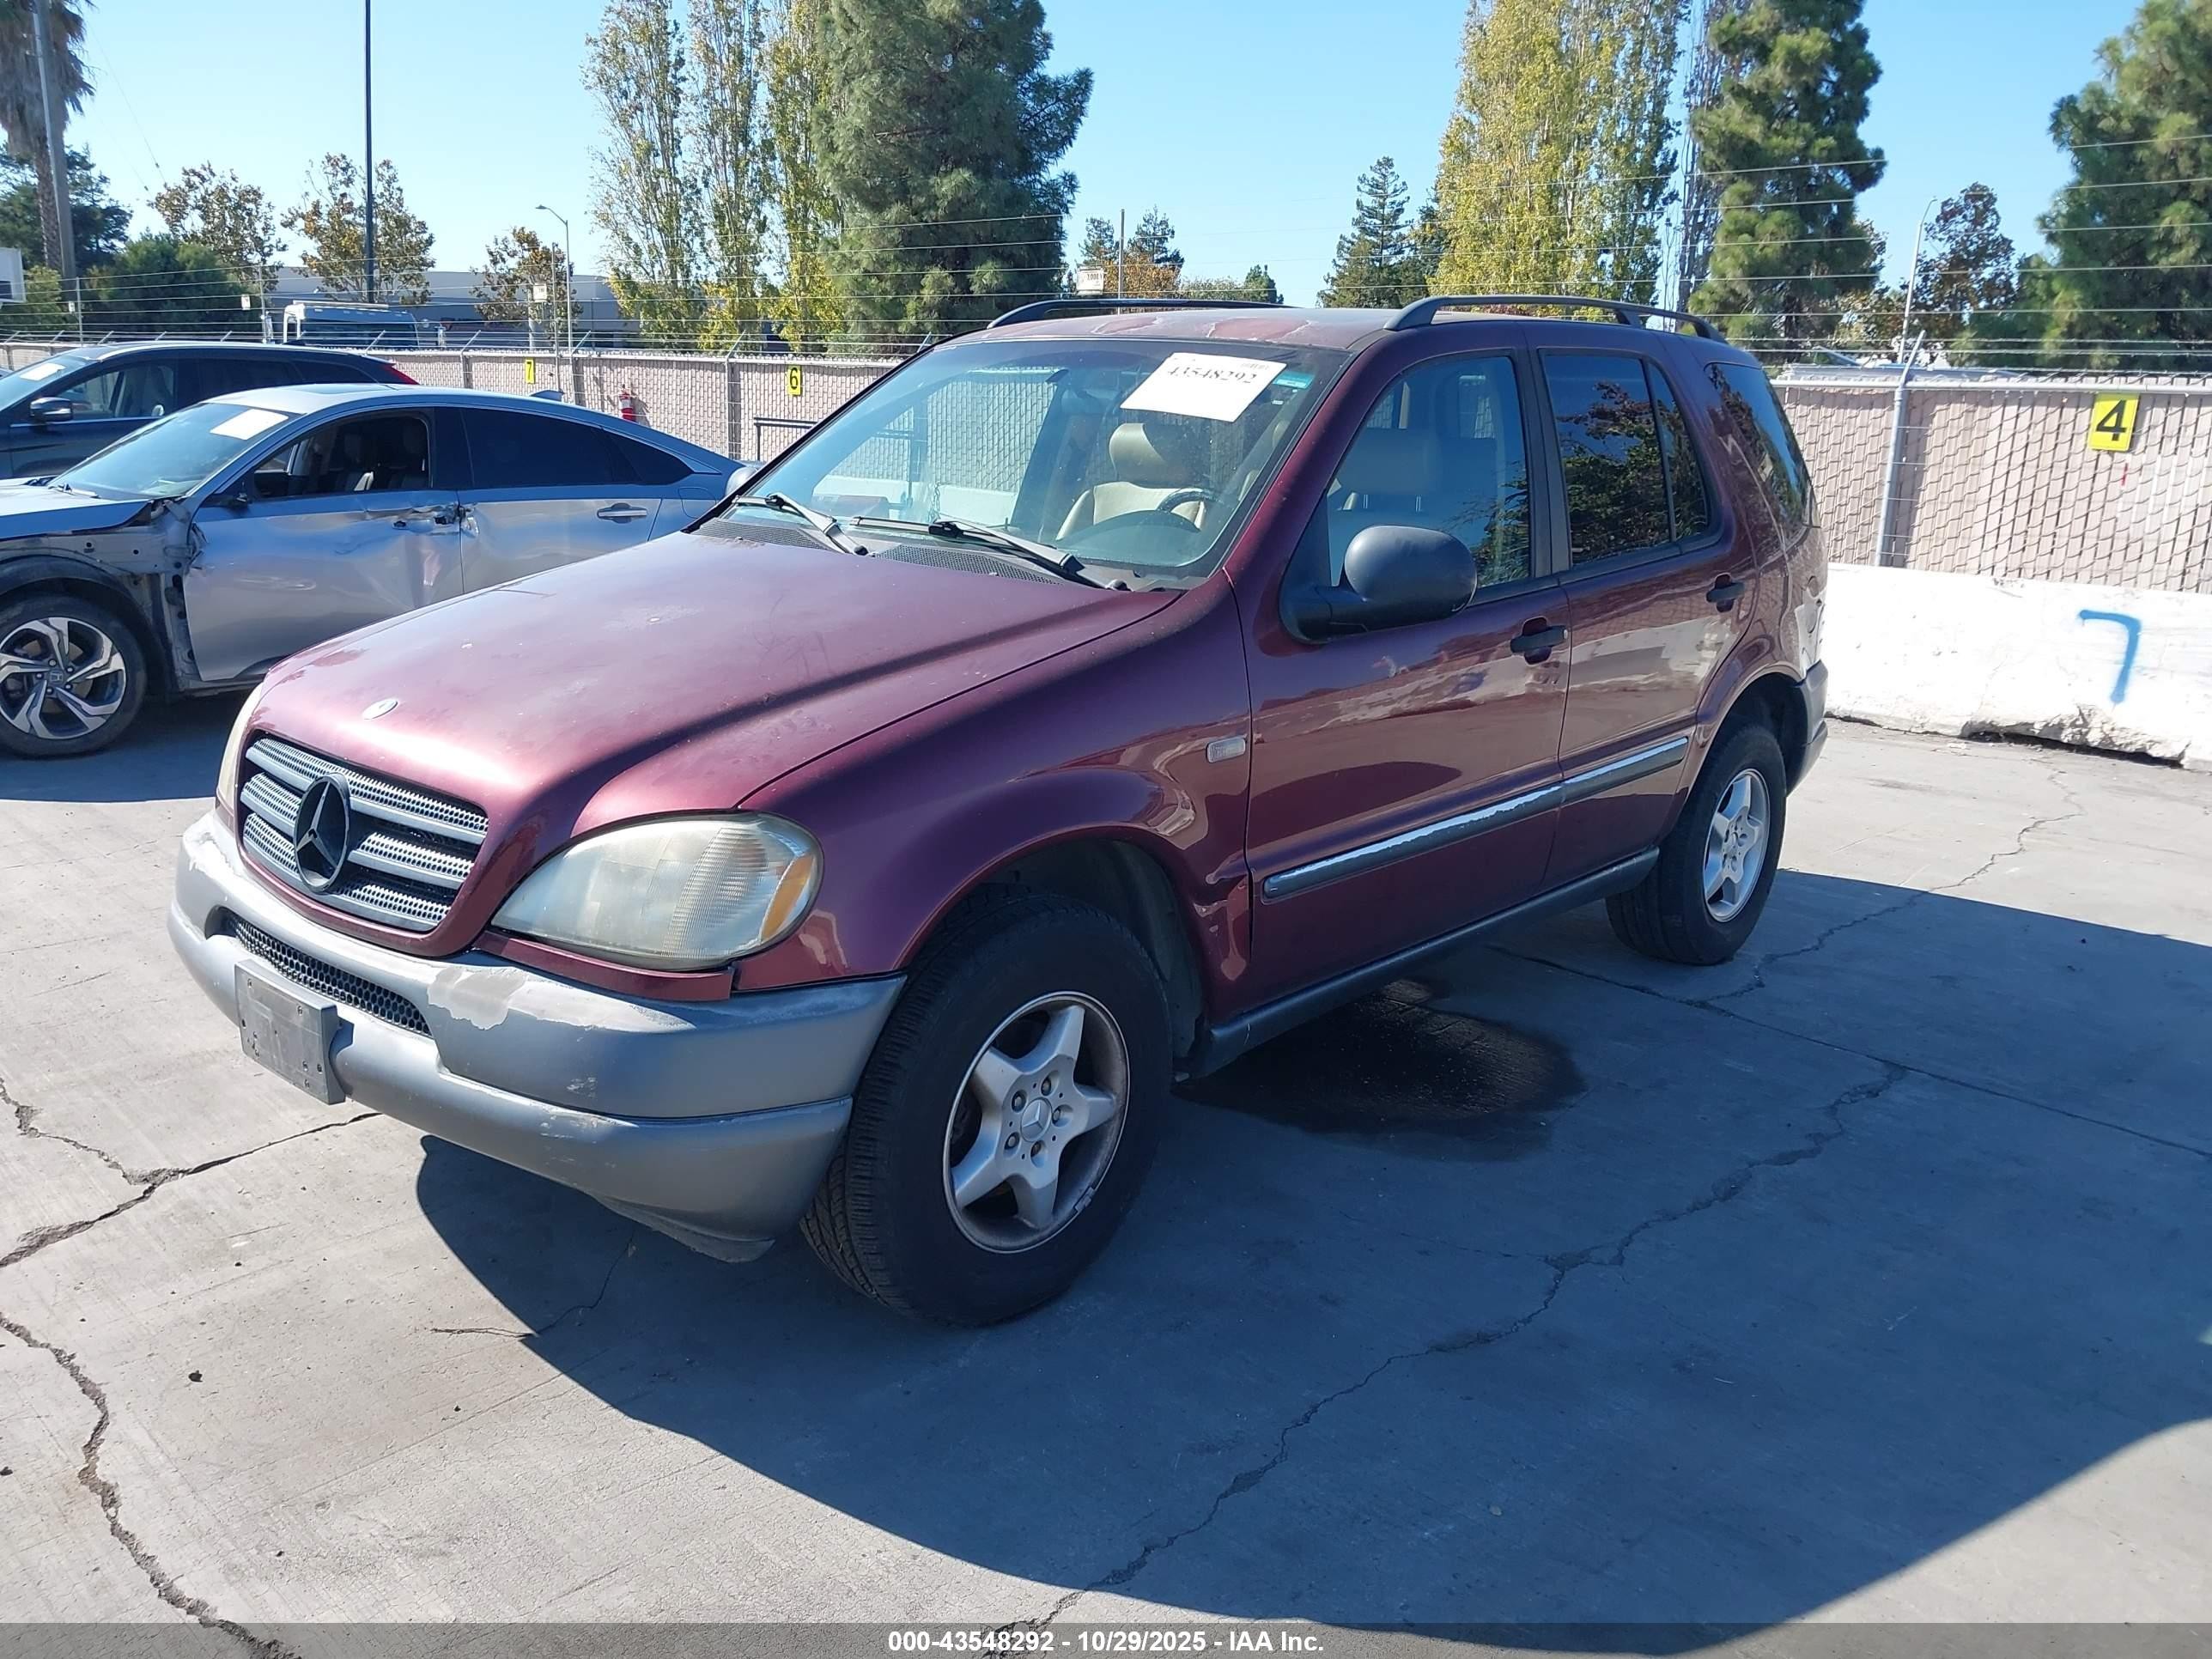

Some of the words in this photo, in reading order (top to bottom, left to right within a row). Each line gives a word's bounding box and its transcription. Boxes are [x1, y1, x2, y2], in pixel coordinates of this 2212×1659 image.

[526, 361, 532, 380] 7
[789, 367, 799, 390] 6
[2095, 398, 2128, 441] 4
[2077, 608, 2143, 704] 7
